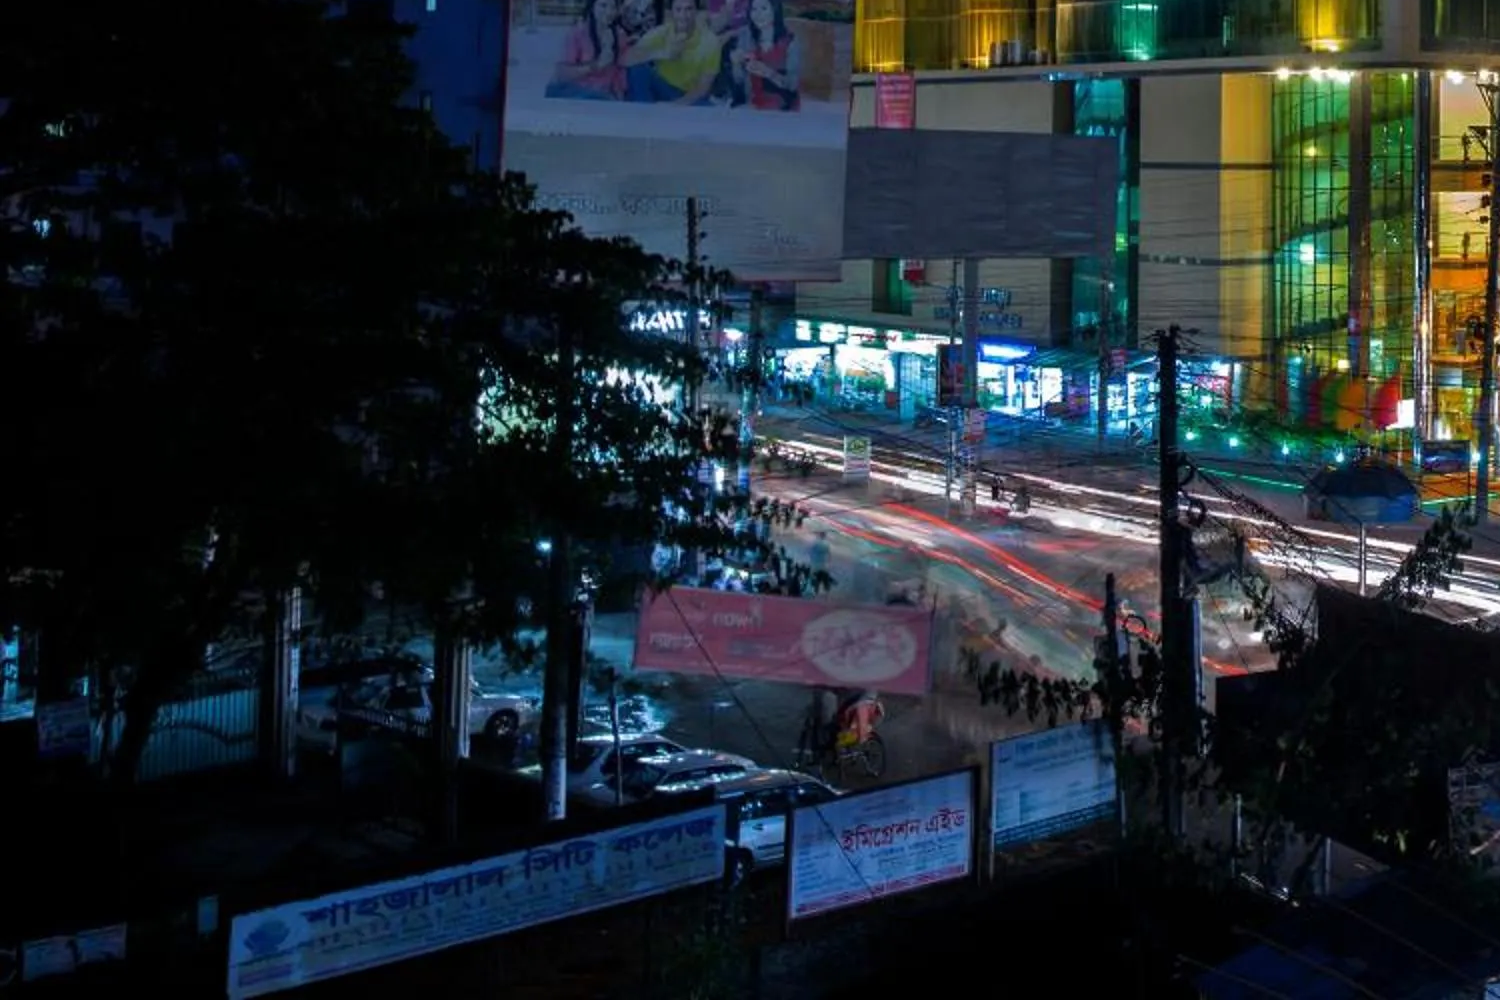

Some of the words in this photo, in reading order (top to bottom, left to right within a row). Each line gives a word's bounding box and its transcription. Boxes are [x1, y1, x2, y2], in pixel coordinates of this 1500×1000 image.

[300, 865, 508, 930] শাহজালাল
[522, 840, 598, 880] সিটি
[612, 815, 719, 855] কলেজ
